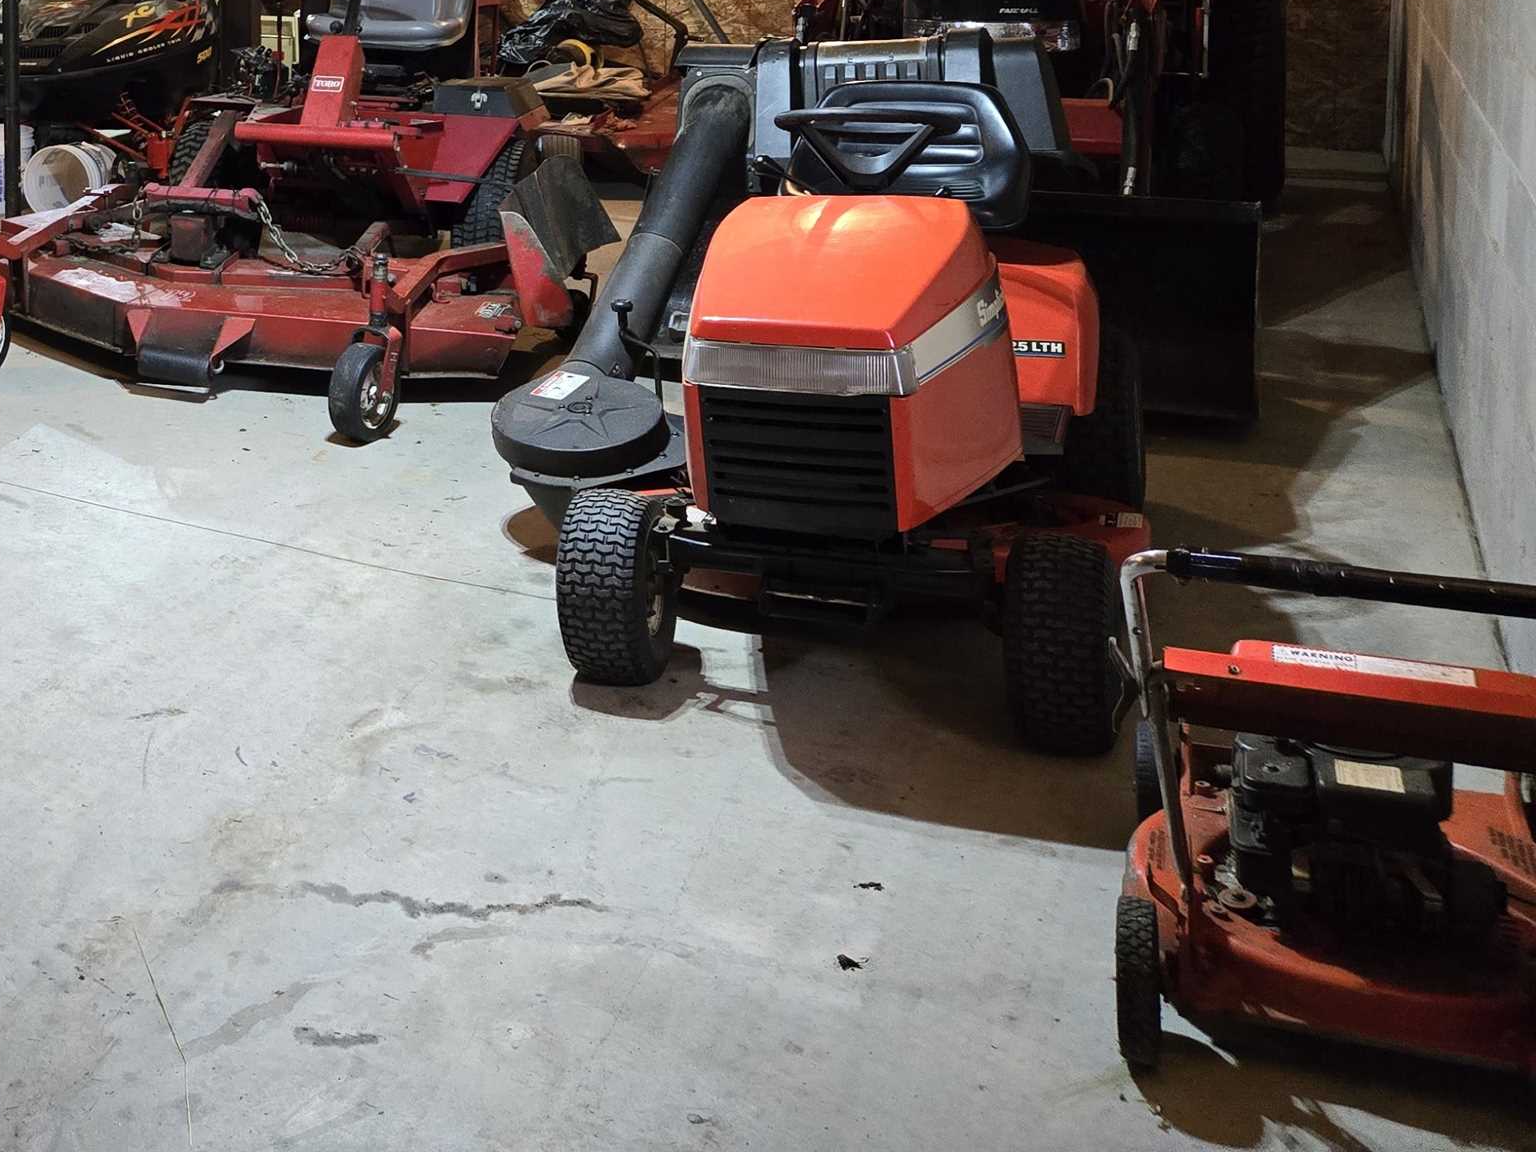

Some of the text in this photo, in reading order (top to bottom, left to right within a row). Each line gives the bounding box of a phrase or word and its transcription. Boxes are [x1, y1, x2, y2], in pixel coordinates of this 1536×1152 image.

[314, 79, 341, 88] TORO
[1031, 341, 1063, 353] LTH
[1291, 650, 1353, 662] WARNING
